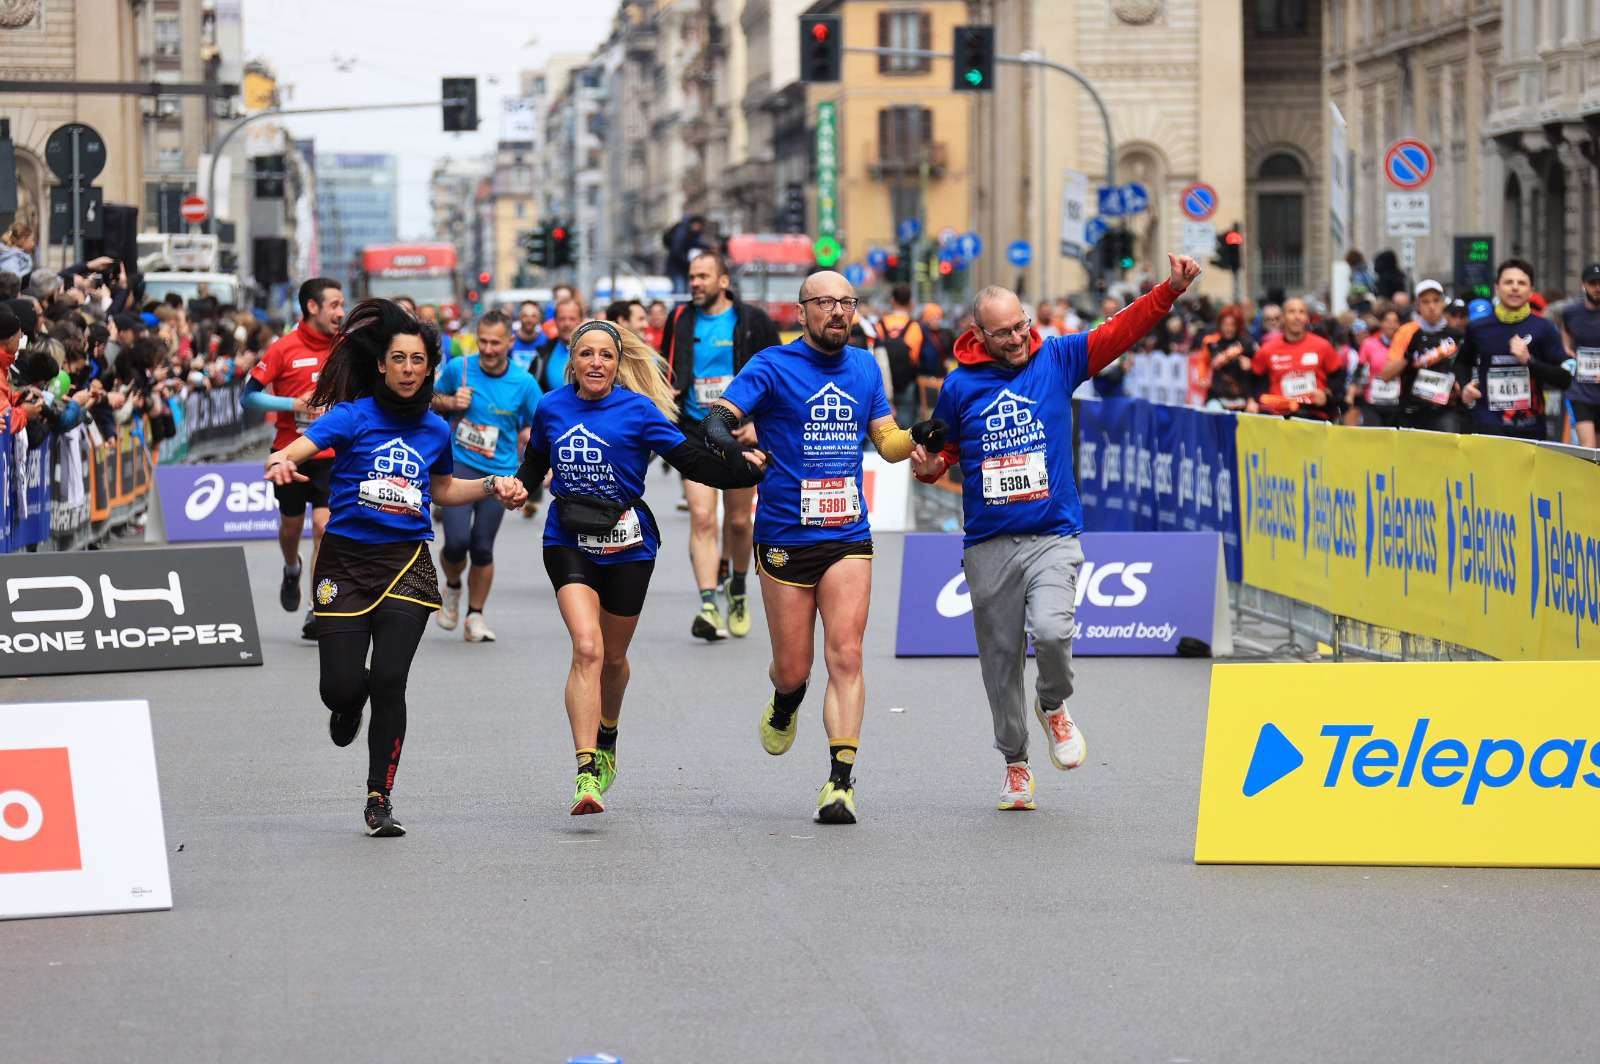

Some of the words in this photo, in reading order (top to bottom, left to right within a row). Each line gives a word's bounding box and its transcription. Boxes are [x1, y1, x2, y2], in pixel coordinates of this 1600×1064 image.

[803, 432, 858, 441] OKLAHOMA
[804, 421, 858, 431] COMUNITÀ
[981, 418, 1045, 442] COMUNITÀ
[982, 430, 1046, 452] OKLAHOMA
[557, 463, 613, 473] COMUNITÀ
[1000, 475, 1031, 492] 538A
[819, 498, 847, 513] 538D
[1251, 448, 1297, 561] Telepass
[1310, 456, 1357, 578] Telepass
[1375, 465, 1437, 597] Telepass
[1455, 472, 1516, 615] Telepass
[1537, 491, 1600, 649] Telepa
[95, 623, 245, 650] HOPPER
[1086, 624, 1134, 639] sound
[1135, 622, 1177, 642] body
